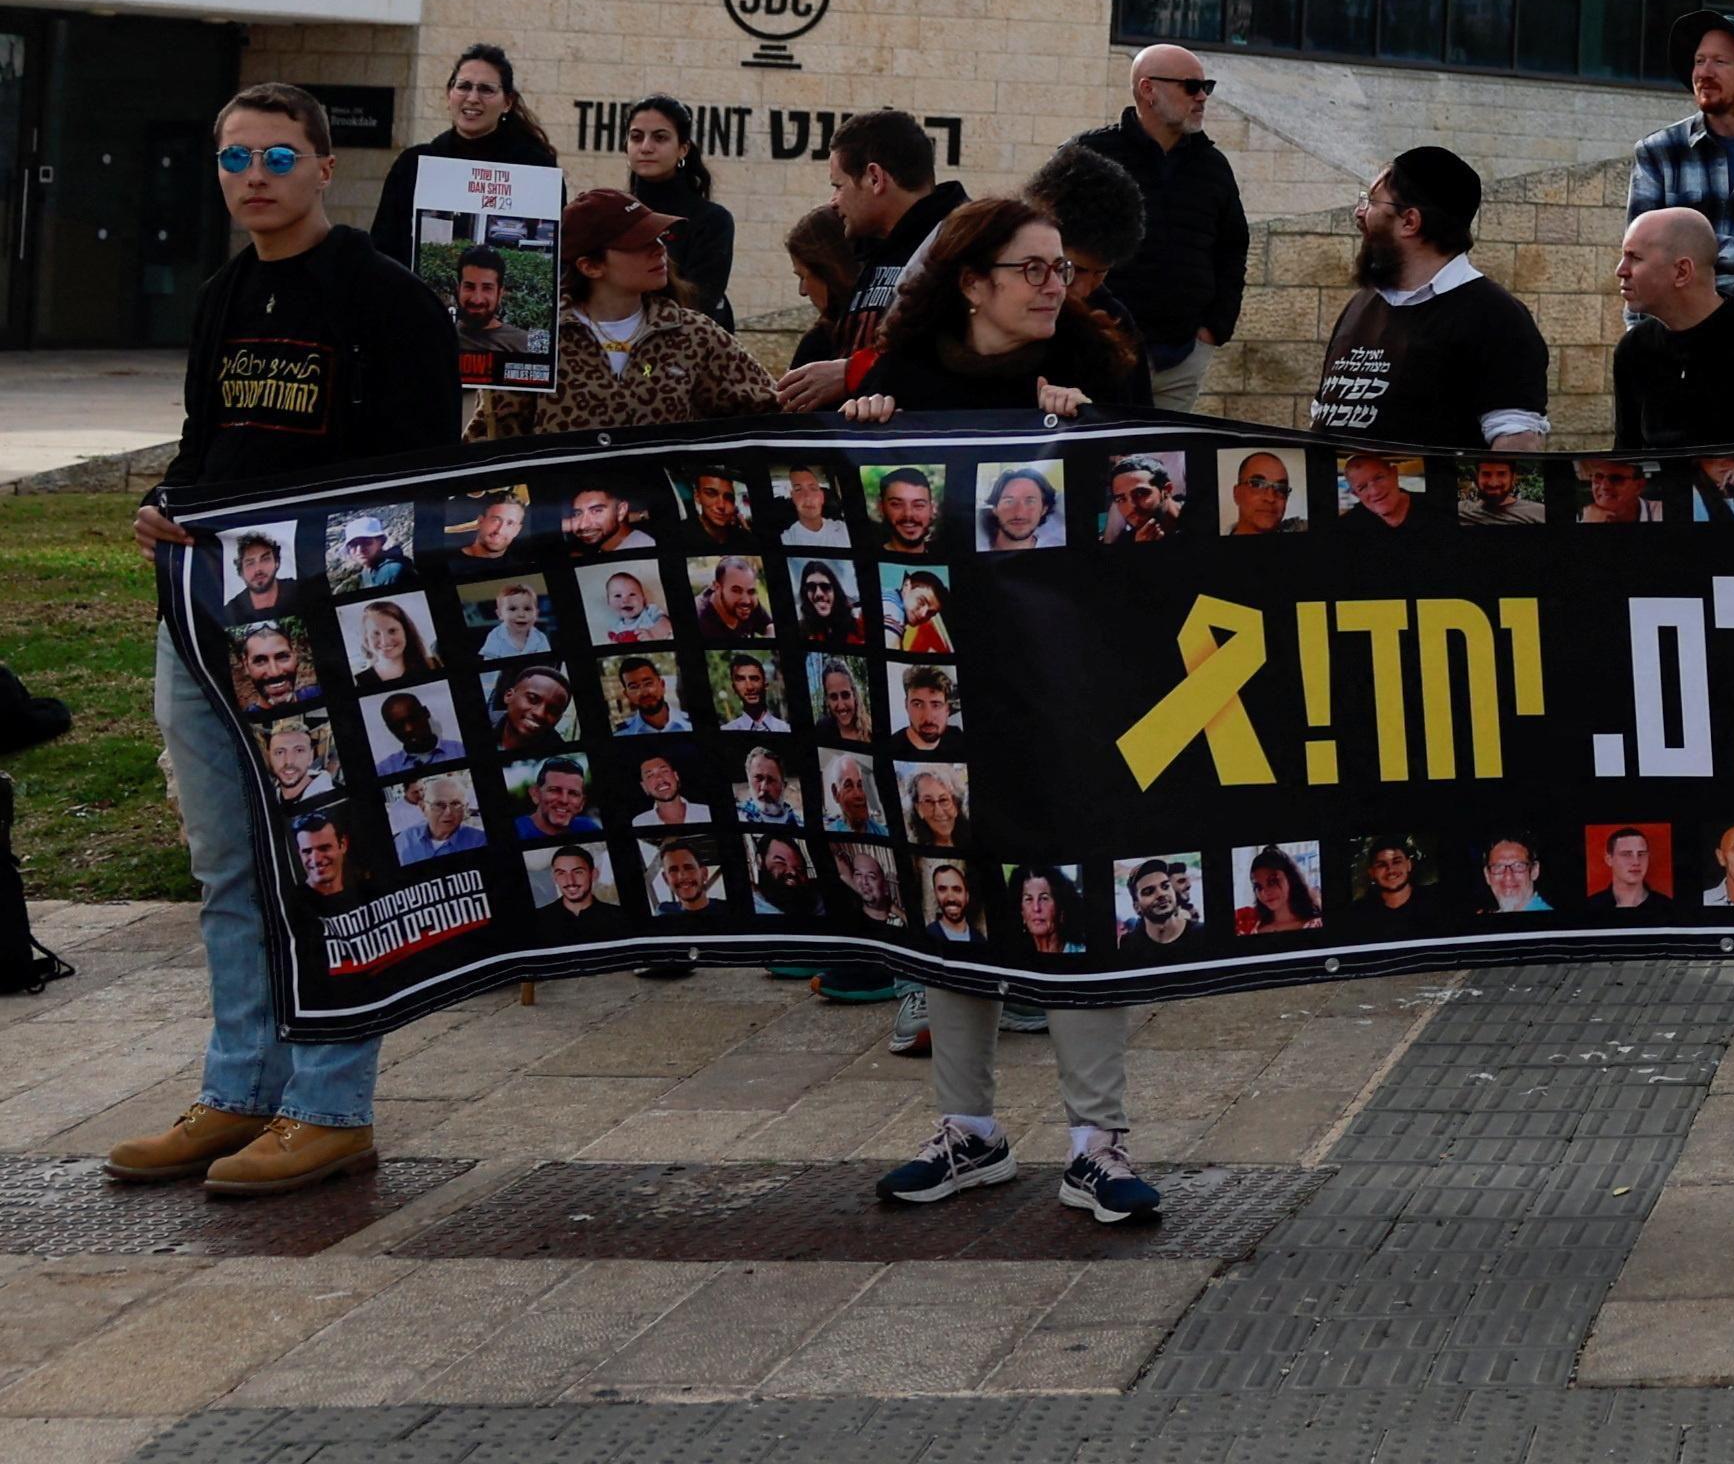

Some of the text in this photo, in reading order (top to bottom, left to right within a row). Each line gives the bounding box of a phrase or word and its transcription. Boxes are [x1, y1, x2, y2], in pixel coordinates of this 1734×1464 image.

[690, 105, 752, 157] INT
[468, 181, 486, 194] IDAN
[1296, 597, 1545, 785] יחד!
[370, 878, 446, 925] המשפחות
[445, 869, 484, 896] מטה
[402, 892, 492, 944] החטופים
